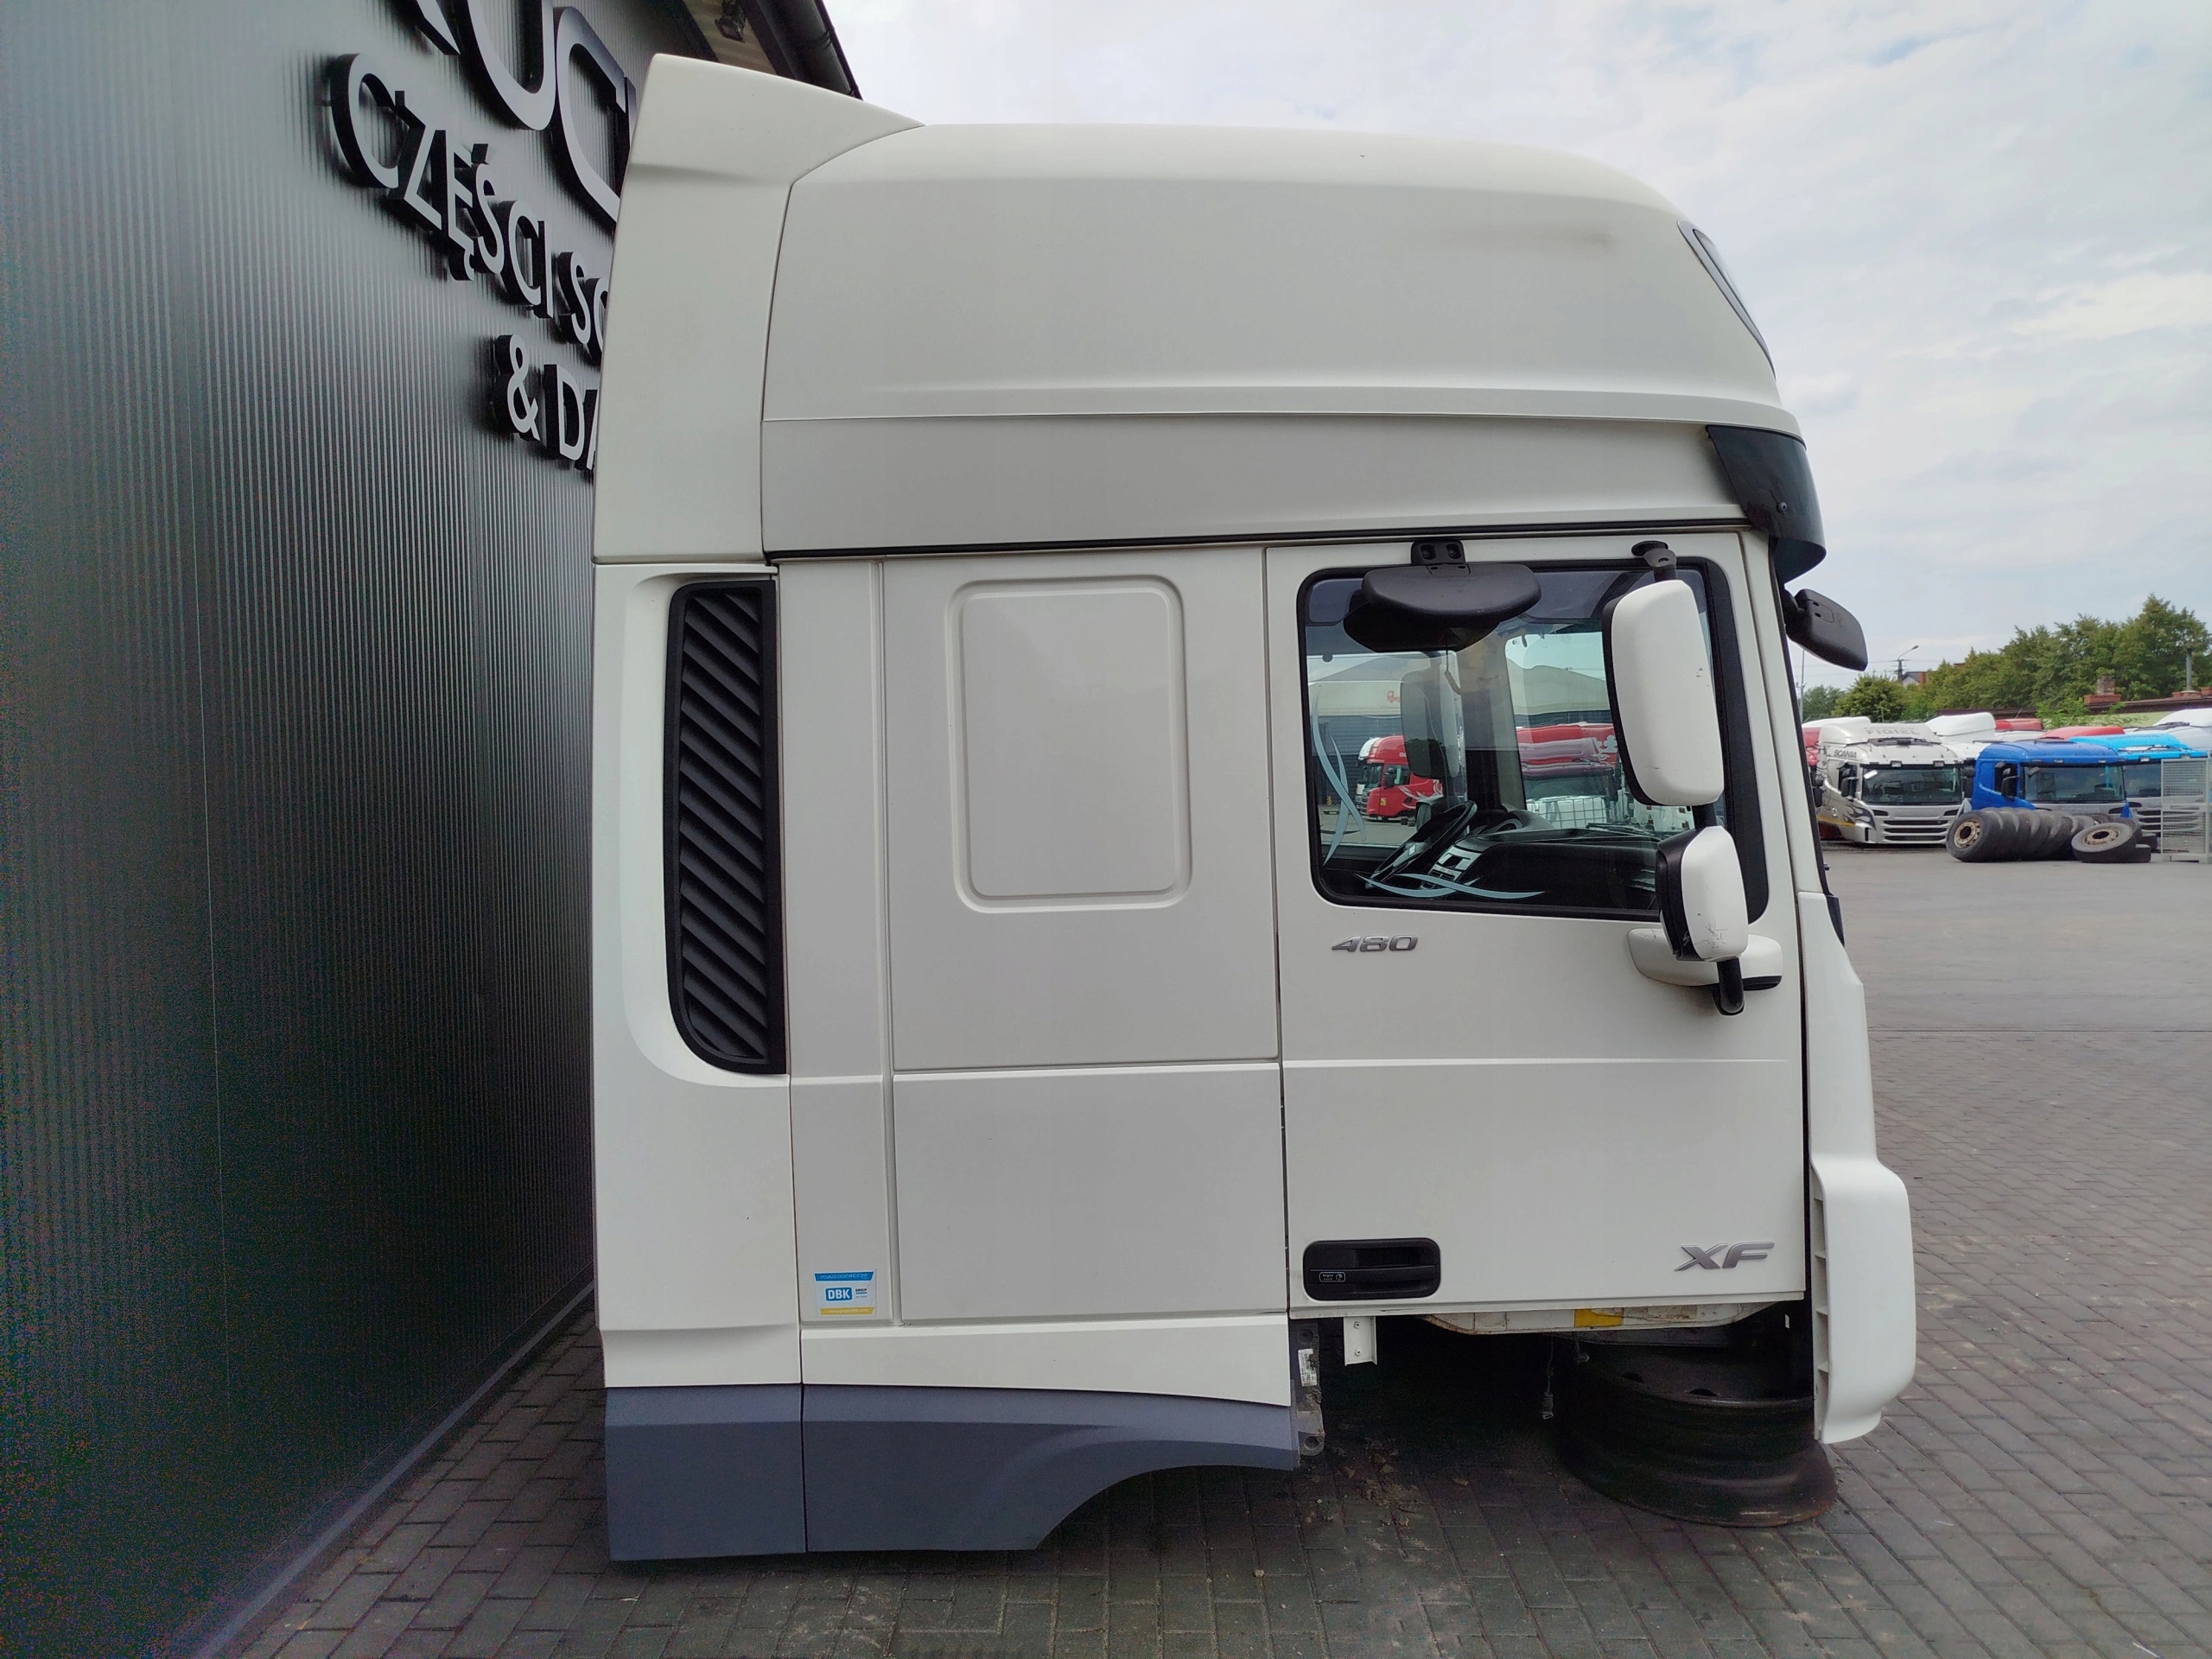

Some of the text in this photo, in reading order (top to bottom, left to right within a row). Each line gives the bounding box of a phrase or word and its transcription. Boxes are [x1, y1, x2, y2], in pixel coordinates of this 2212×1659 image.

[333, 54, 554, 318] CZĘŚCI
[499, 334, 539, 441] &
[1834, 749, 1857, 759] SCANIA
[1332, 935, 1418, 952] 480
[1674, 1242, 1775, 1271] XF
[828, 1288, 850, 1300] DBK
